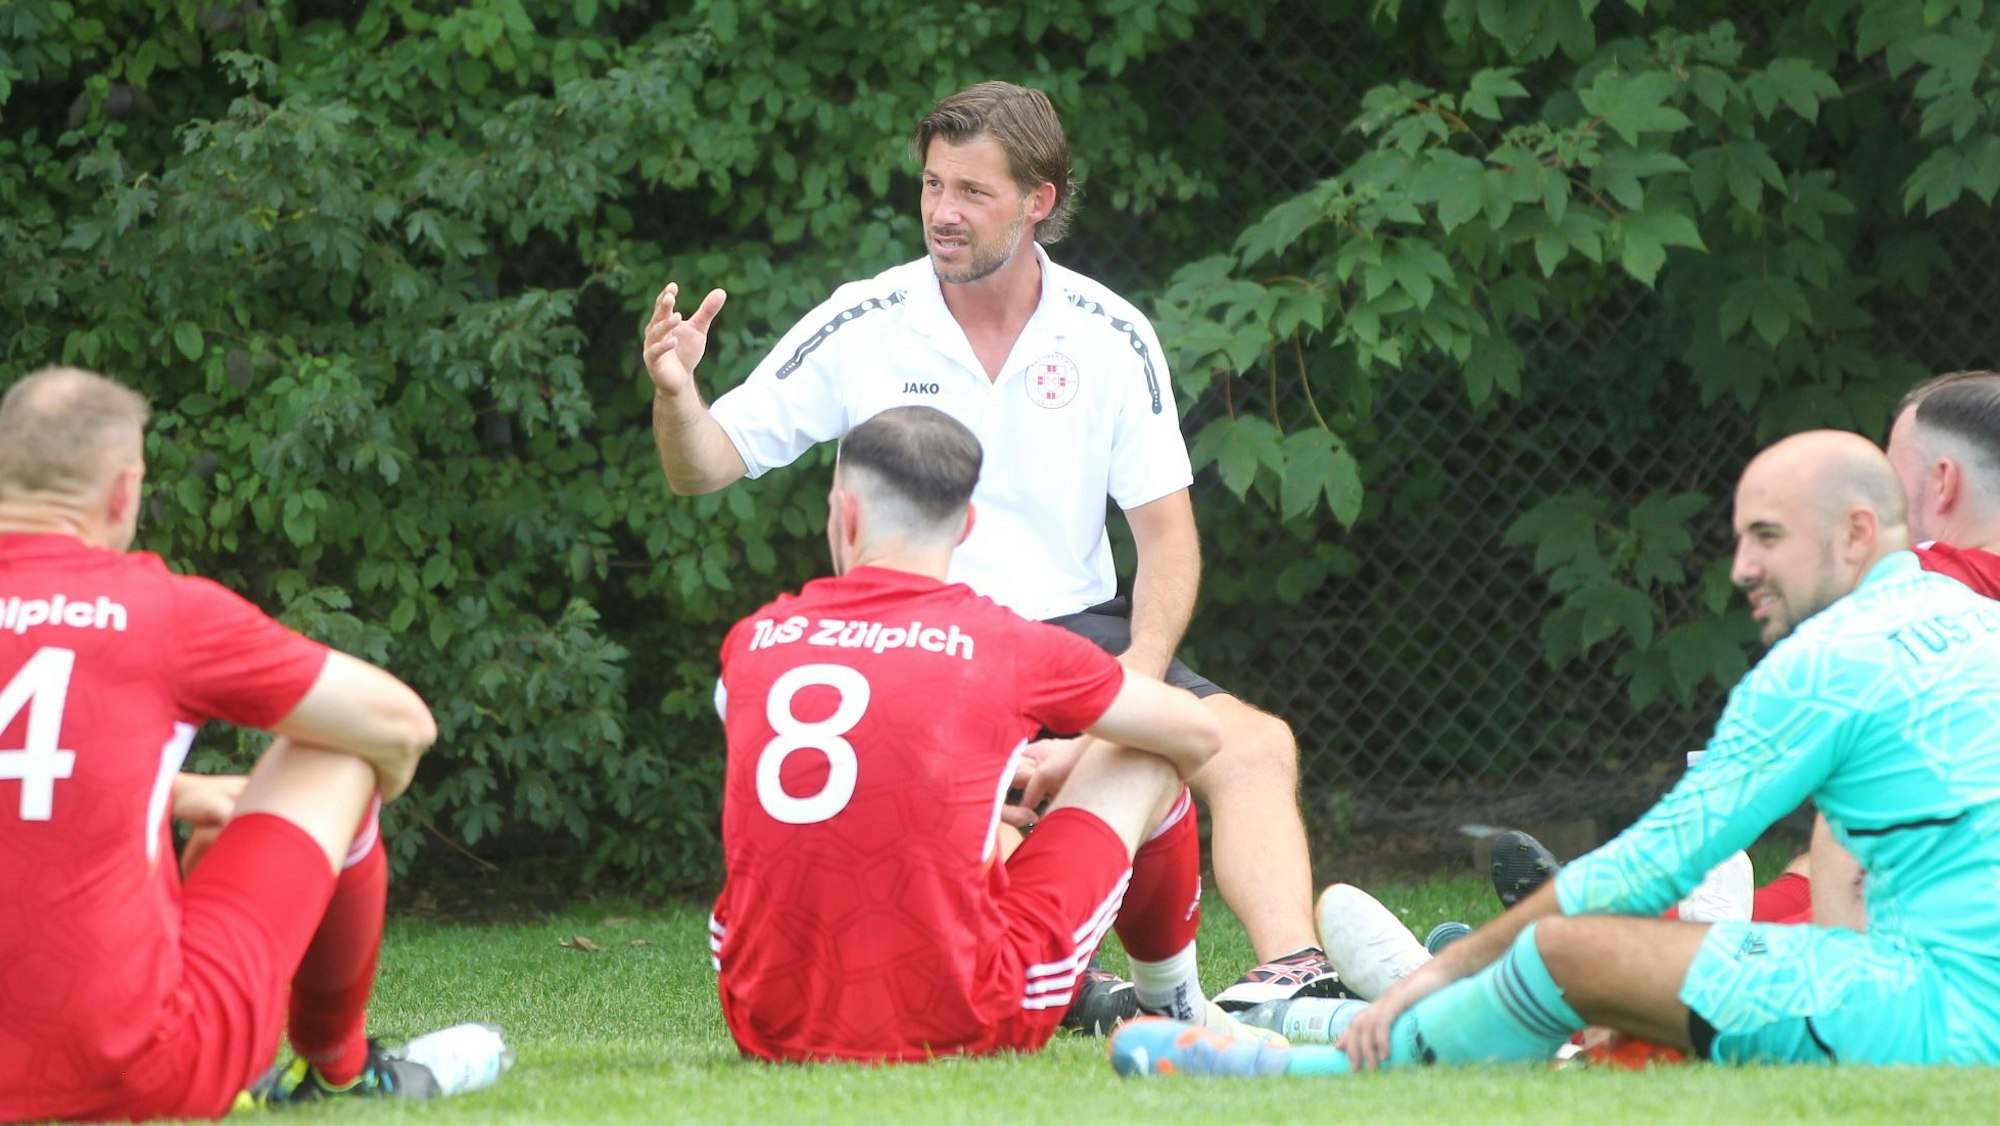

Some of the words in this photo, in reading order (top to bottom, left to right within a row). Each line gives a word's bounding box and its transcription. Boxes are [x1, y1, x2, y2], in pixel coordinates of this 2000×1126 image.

[902, 382, 940, 395] JAKO
[808, 619, 974, 660] Zülpich
[0, 645, 76, 821] 4
[756, 663, 871, 824] 8
